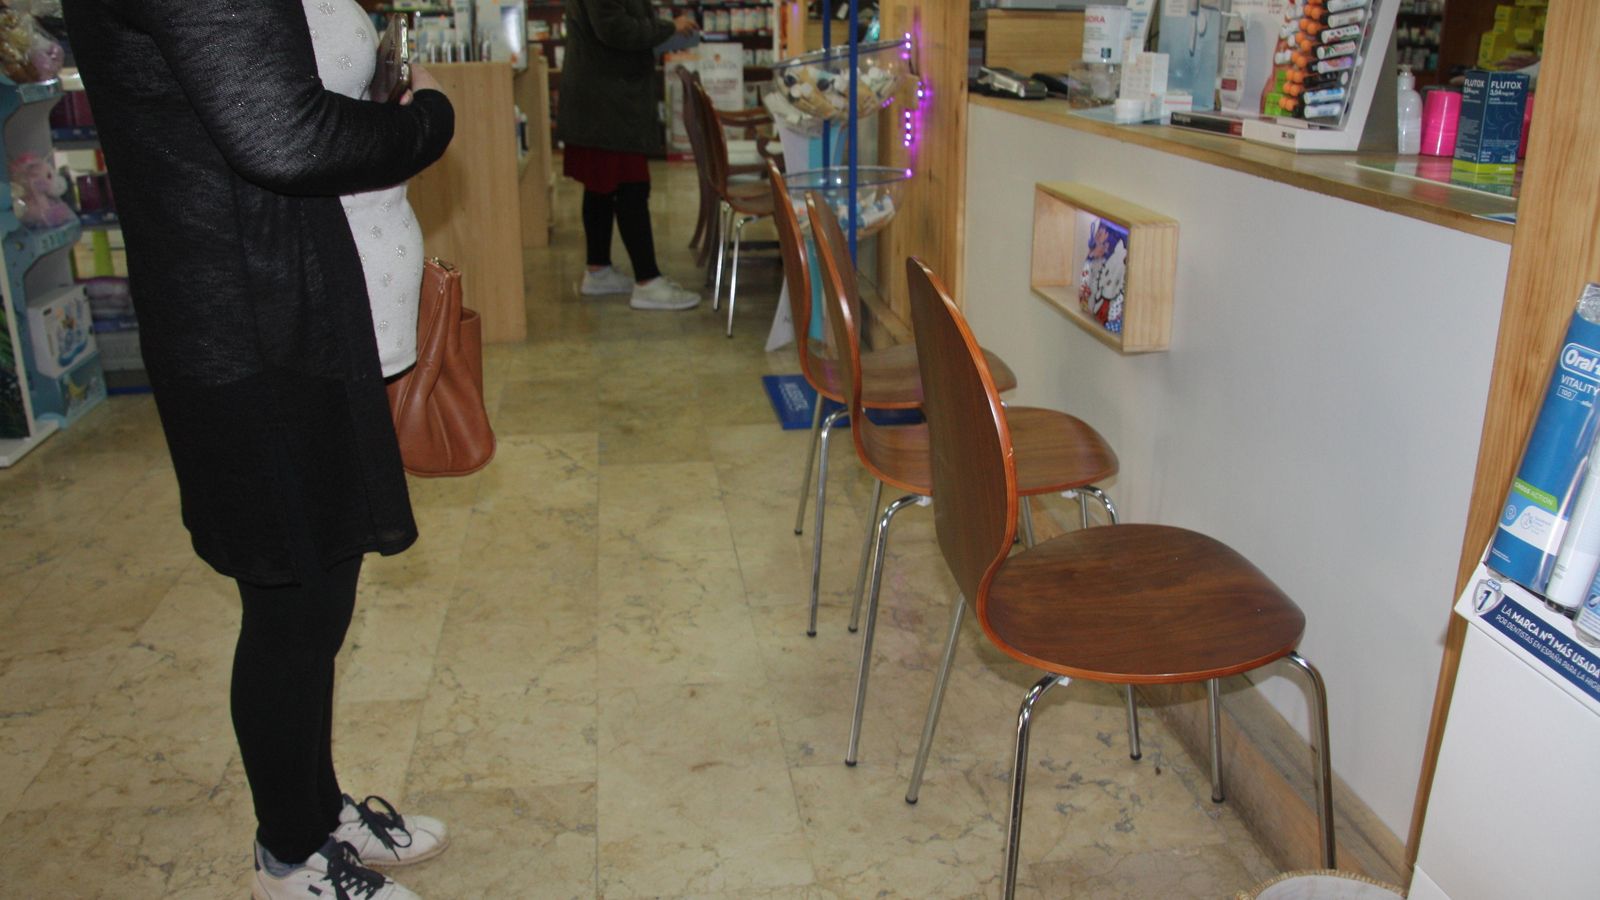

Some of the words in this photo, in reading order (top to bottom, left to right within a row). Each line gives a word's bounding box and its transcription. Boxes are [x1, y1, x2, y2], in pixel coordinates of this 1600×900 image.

[1491, 81, 1522, 90] FLUTOX
[1561, 375, 1600, 396] VITALITY
[1530, 490, 1554, 507] ACTION
[1495, 615, 1507, 626] POR
[1506, 620, 1534, 644] DENTISTAS
[1532, 639, 1541, 649] EN
[1540, 645, 1561, 664] ESPAÑA
[1561, 660, 1577, 675] PARA
[1576, 671, 1586, 681] LA
[1501, 604, 1512, 616] LA
[1511, 612, 1539, 636] MARCA
[1553, 643, 1573, 658] MÁS
[1571, 652, 1600, 678] USADA
